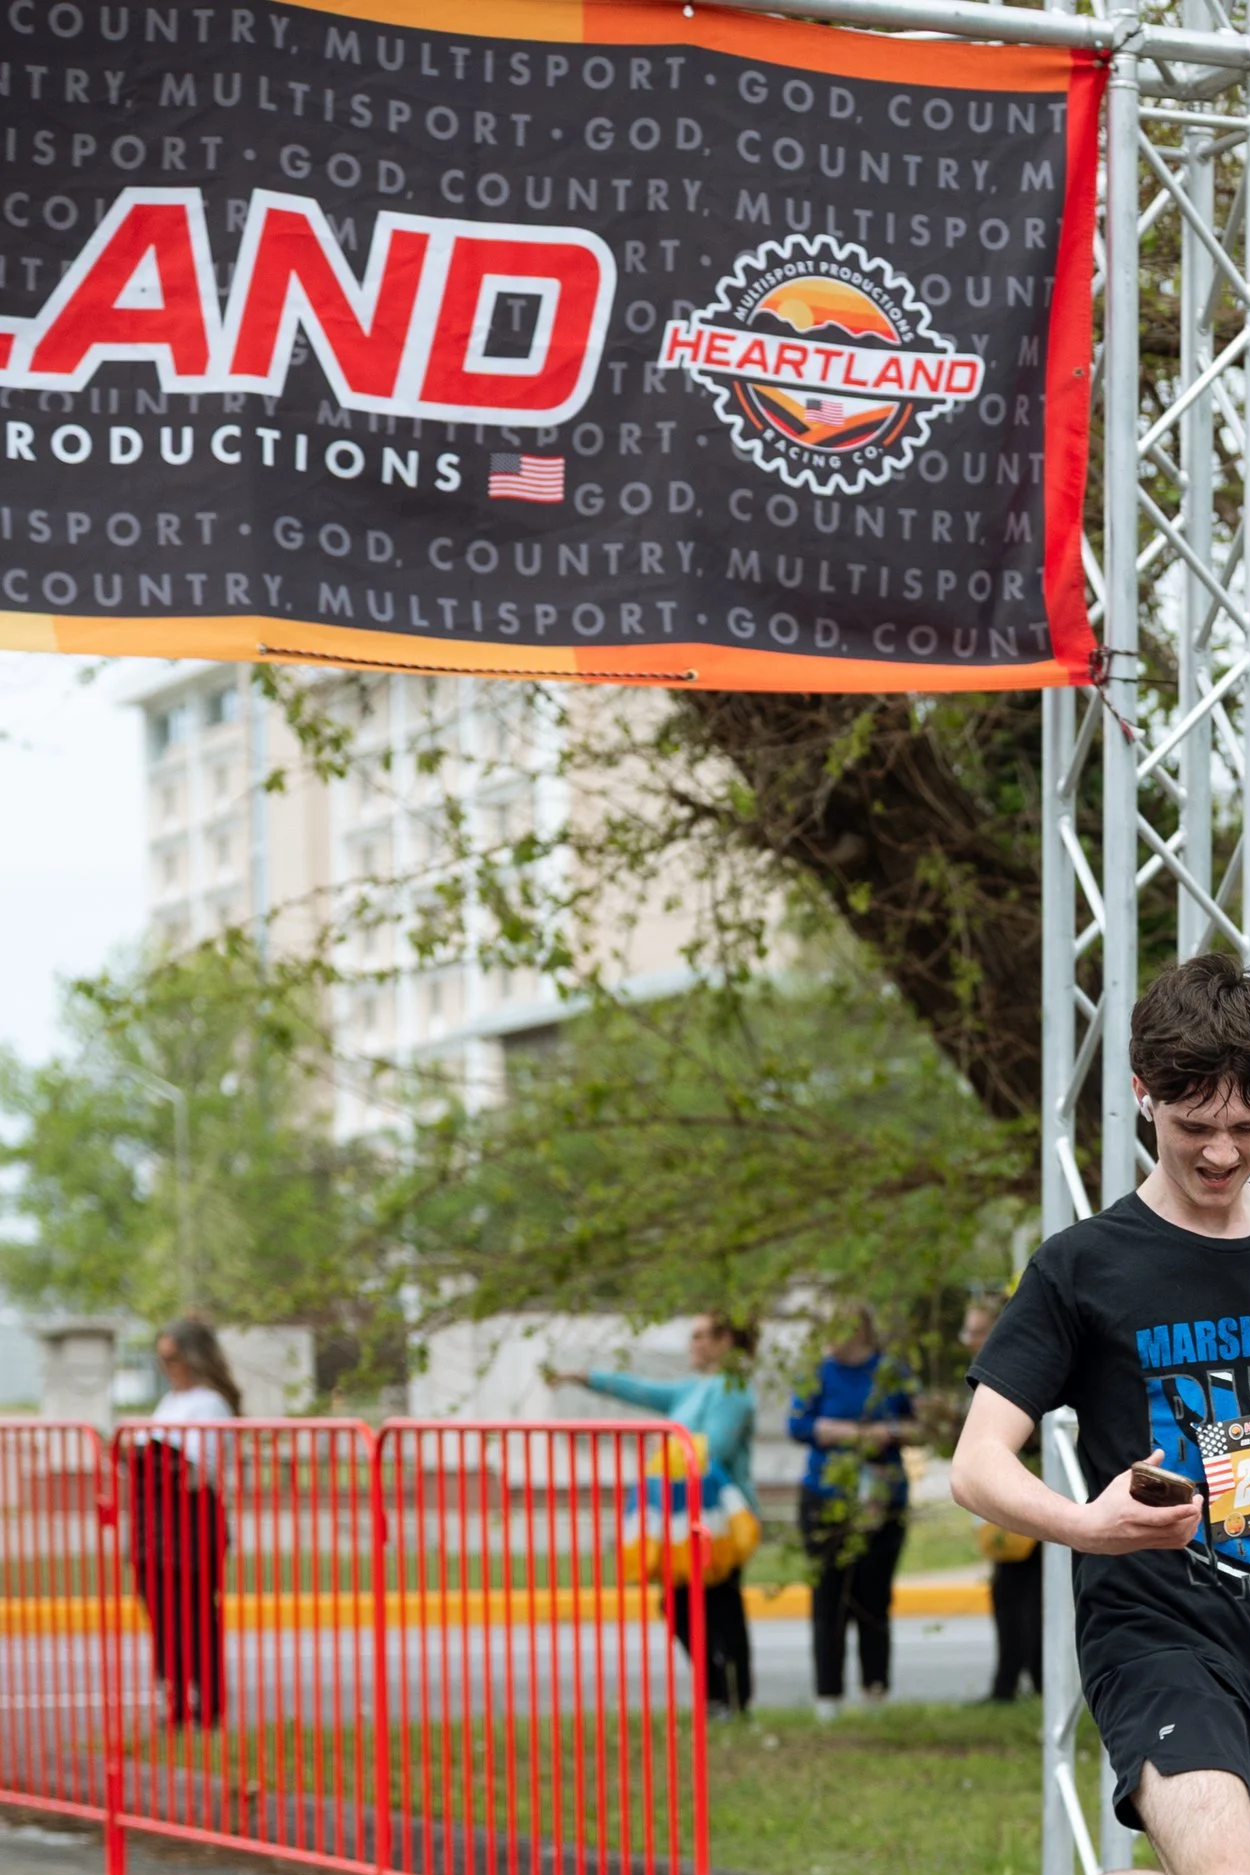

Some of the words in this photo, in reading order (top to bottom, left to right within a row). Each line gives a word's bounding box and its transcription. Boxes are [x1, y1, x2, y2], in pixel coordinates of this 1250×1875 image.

[8, 0, 299, 54] COUNTRY,
[324, 26, 686, 89] MULTISPORT
[738, 70, 863, 125] GOD,
[159, 72, 531, 147] MULTISPORT
[584, 117, 711, 157] GOD,
[737, 130, 998, 194] COUNTRY,
[280, 144, 413, 201] GOD,
[440, 169, 710, 218] COUNTRY,
[735, 188, 1063, 251] MULTISPOR
[0, 186, 616, 427] AND
[733, 260, 816, 324] MULTISPORT
[818, 260, 915, 345] PRODUCTIONS
[664, 326, 979, 394] HEARTLAND
[762, 428, 842, 469] RACING
[573, 481, 703, 518] GOD,
[728, 488, 987, 546] COUNTRY,
[273, 516, 402, 568] GOD,
[428, 537, 703, 579] COUNTRY,
[726, 548, 1045, 601] MULTISPOR
[2, 568, 293, 611] COUNTRY,
[318, 582, 677, 636] MULTISPORT
[727, 606, 848, 652] GOD,
